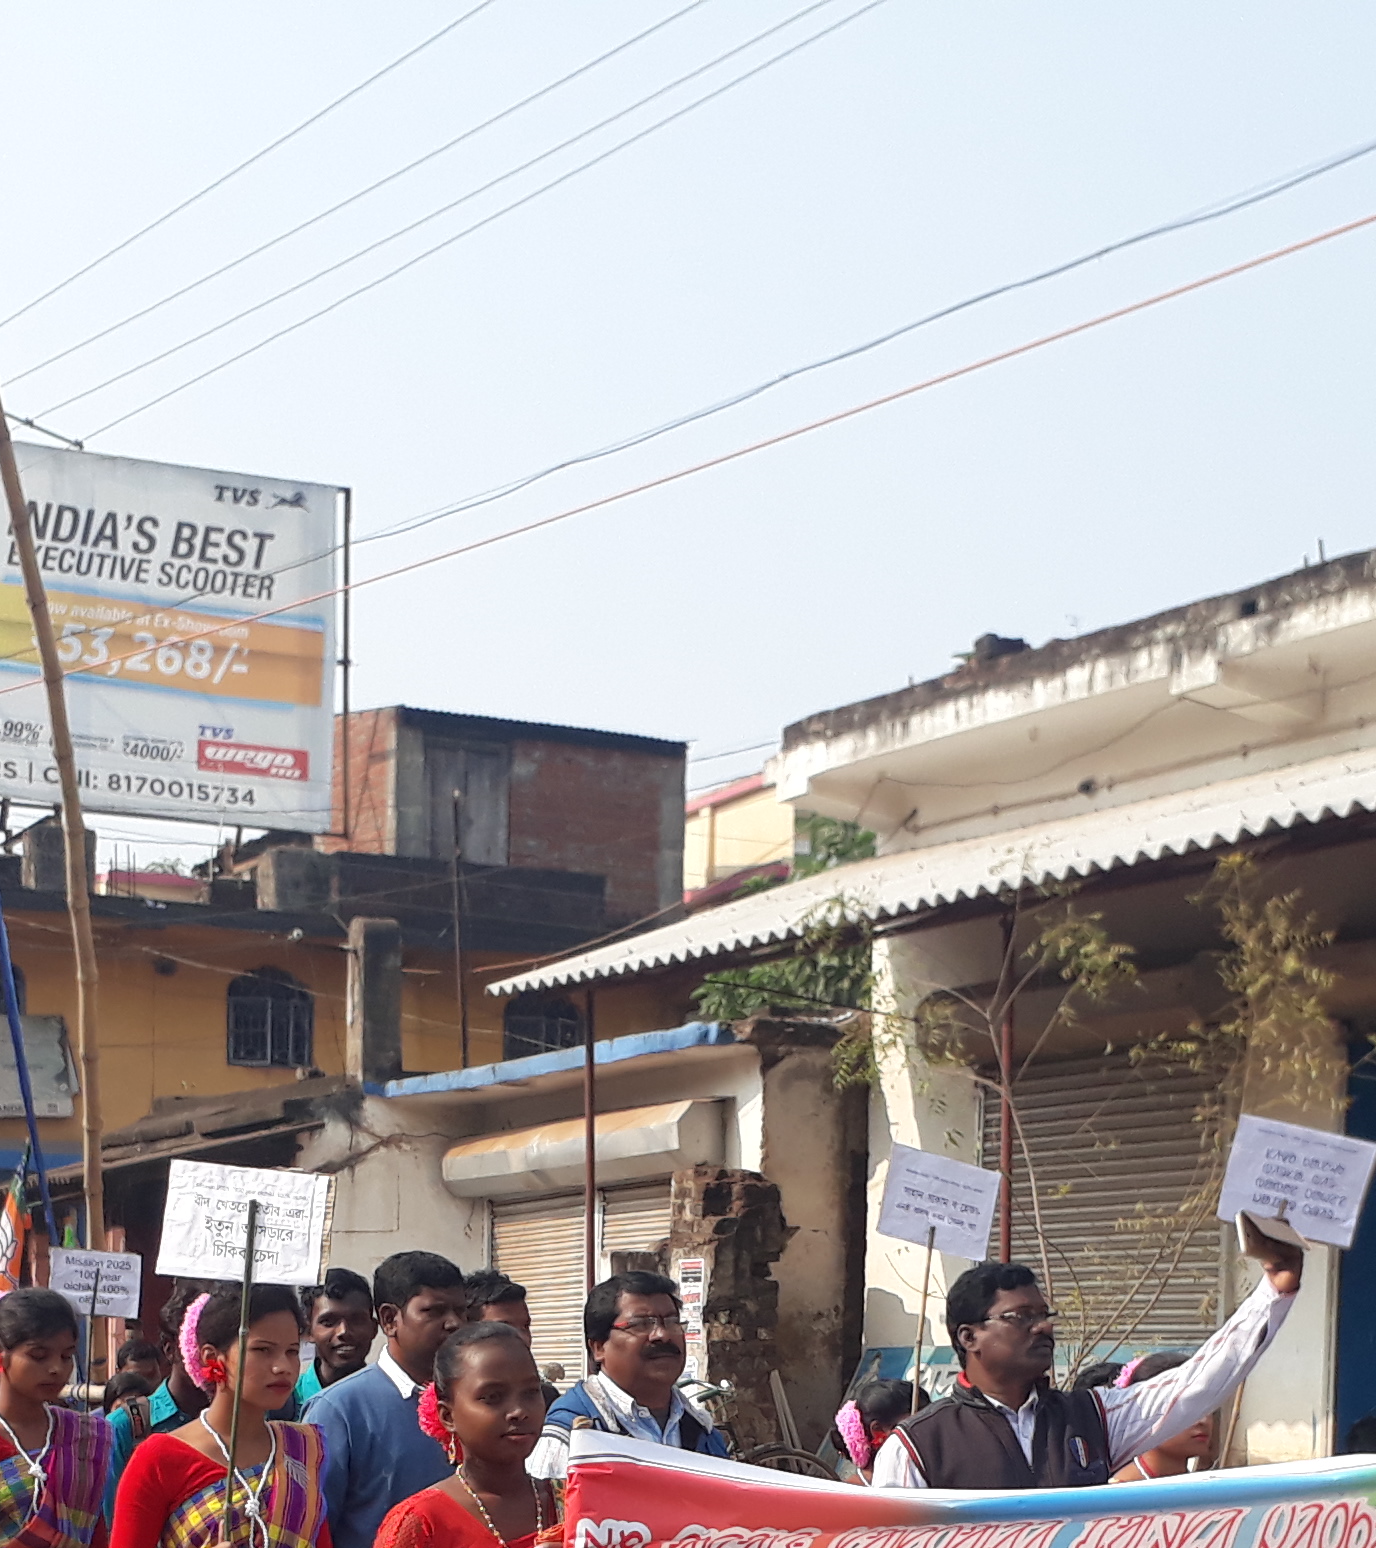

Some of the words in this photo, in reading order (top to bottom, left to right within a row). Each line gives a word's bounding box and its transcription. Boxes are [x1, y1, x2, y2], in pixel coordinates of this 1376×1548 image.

[214, 484, 262, 507] TVS
[8, 499, 160, 554] NDIA'S
[171, 520, 275, 569] BEST
[157, 561, 275, 601] SCOOTER
[198, 723, 234, 740] TVS
[43, 766, 99, 790] Cll:
[108, 773, 256, 807] 8170015734
[65, 1255, 103, 1268] Mission
